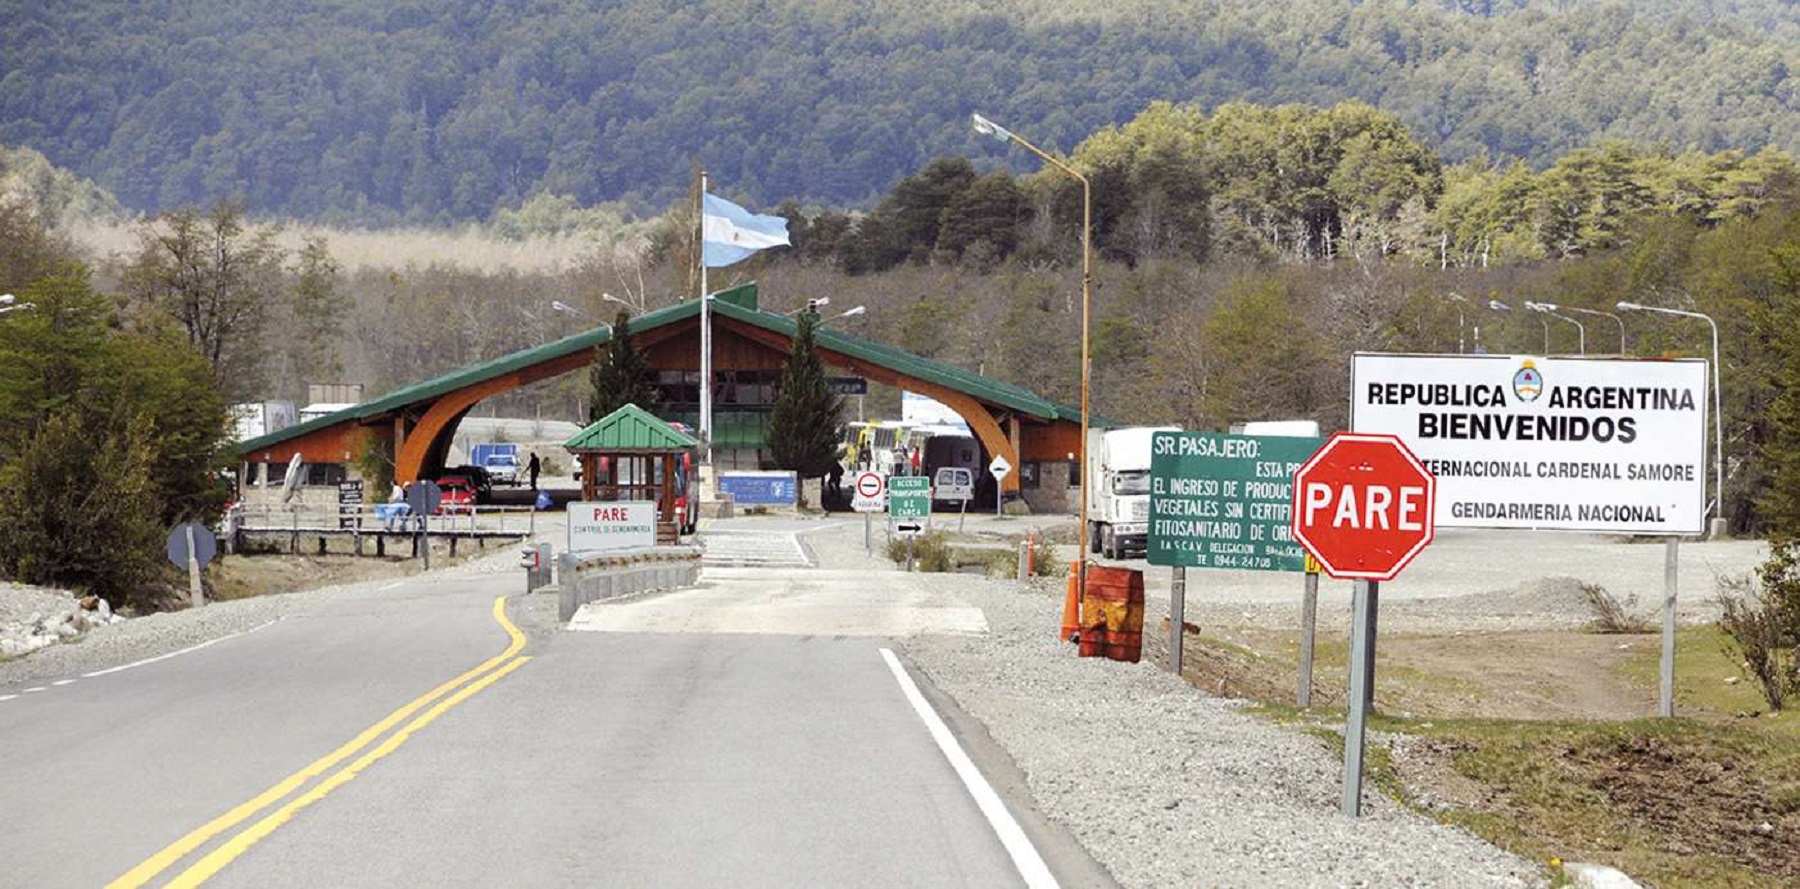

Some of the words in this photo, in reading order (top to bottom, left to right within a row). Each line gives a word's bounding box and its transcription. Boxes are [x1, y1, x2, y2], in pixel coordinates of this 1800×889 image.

[1368, 383, 1507, 407] REPUBLICA
[1549, 386, 1696, 411] ARGENTINA
[1418, 413, 1637, 443] BIENVENIDOS
[1256, 462, 1284, 478] ESTA
[1537, 462, 1622, 480] CARDENAL
[1627, 463, 1695, 481] SAMORE
[1154, 477, 1166, 494] EL
[1170, 478, 1218, 496] INGRESO
[1223, 481, 1238, 497] DE
[594, 508, 629, 522] PARE
[1154, 499, 1219, 517] VEGETALES
[1225, 502, 1243, 519] SIN
[1305, 482, 1423, 531] PARE
[1451, 502, 1572, 521] GENDARMERIA
[1578, 504, 1665, 522] NACIONAL
[1155, 520, 1241, 539] FITOSANITARIO
[1250, 524, 1265, 541] DE
